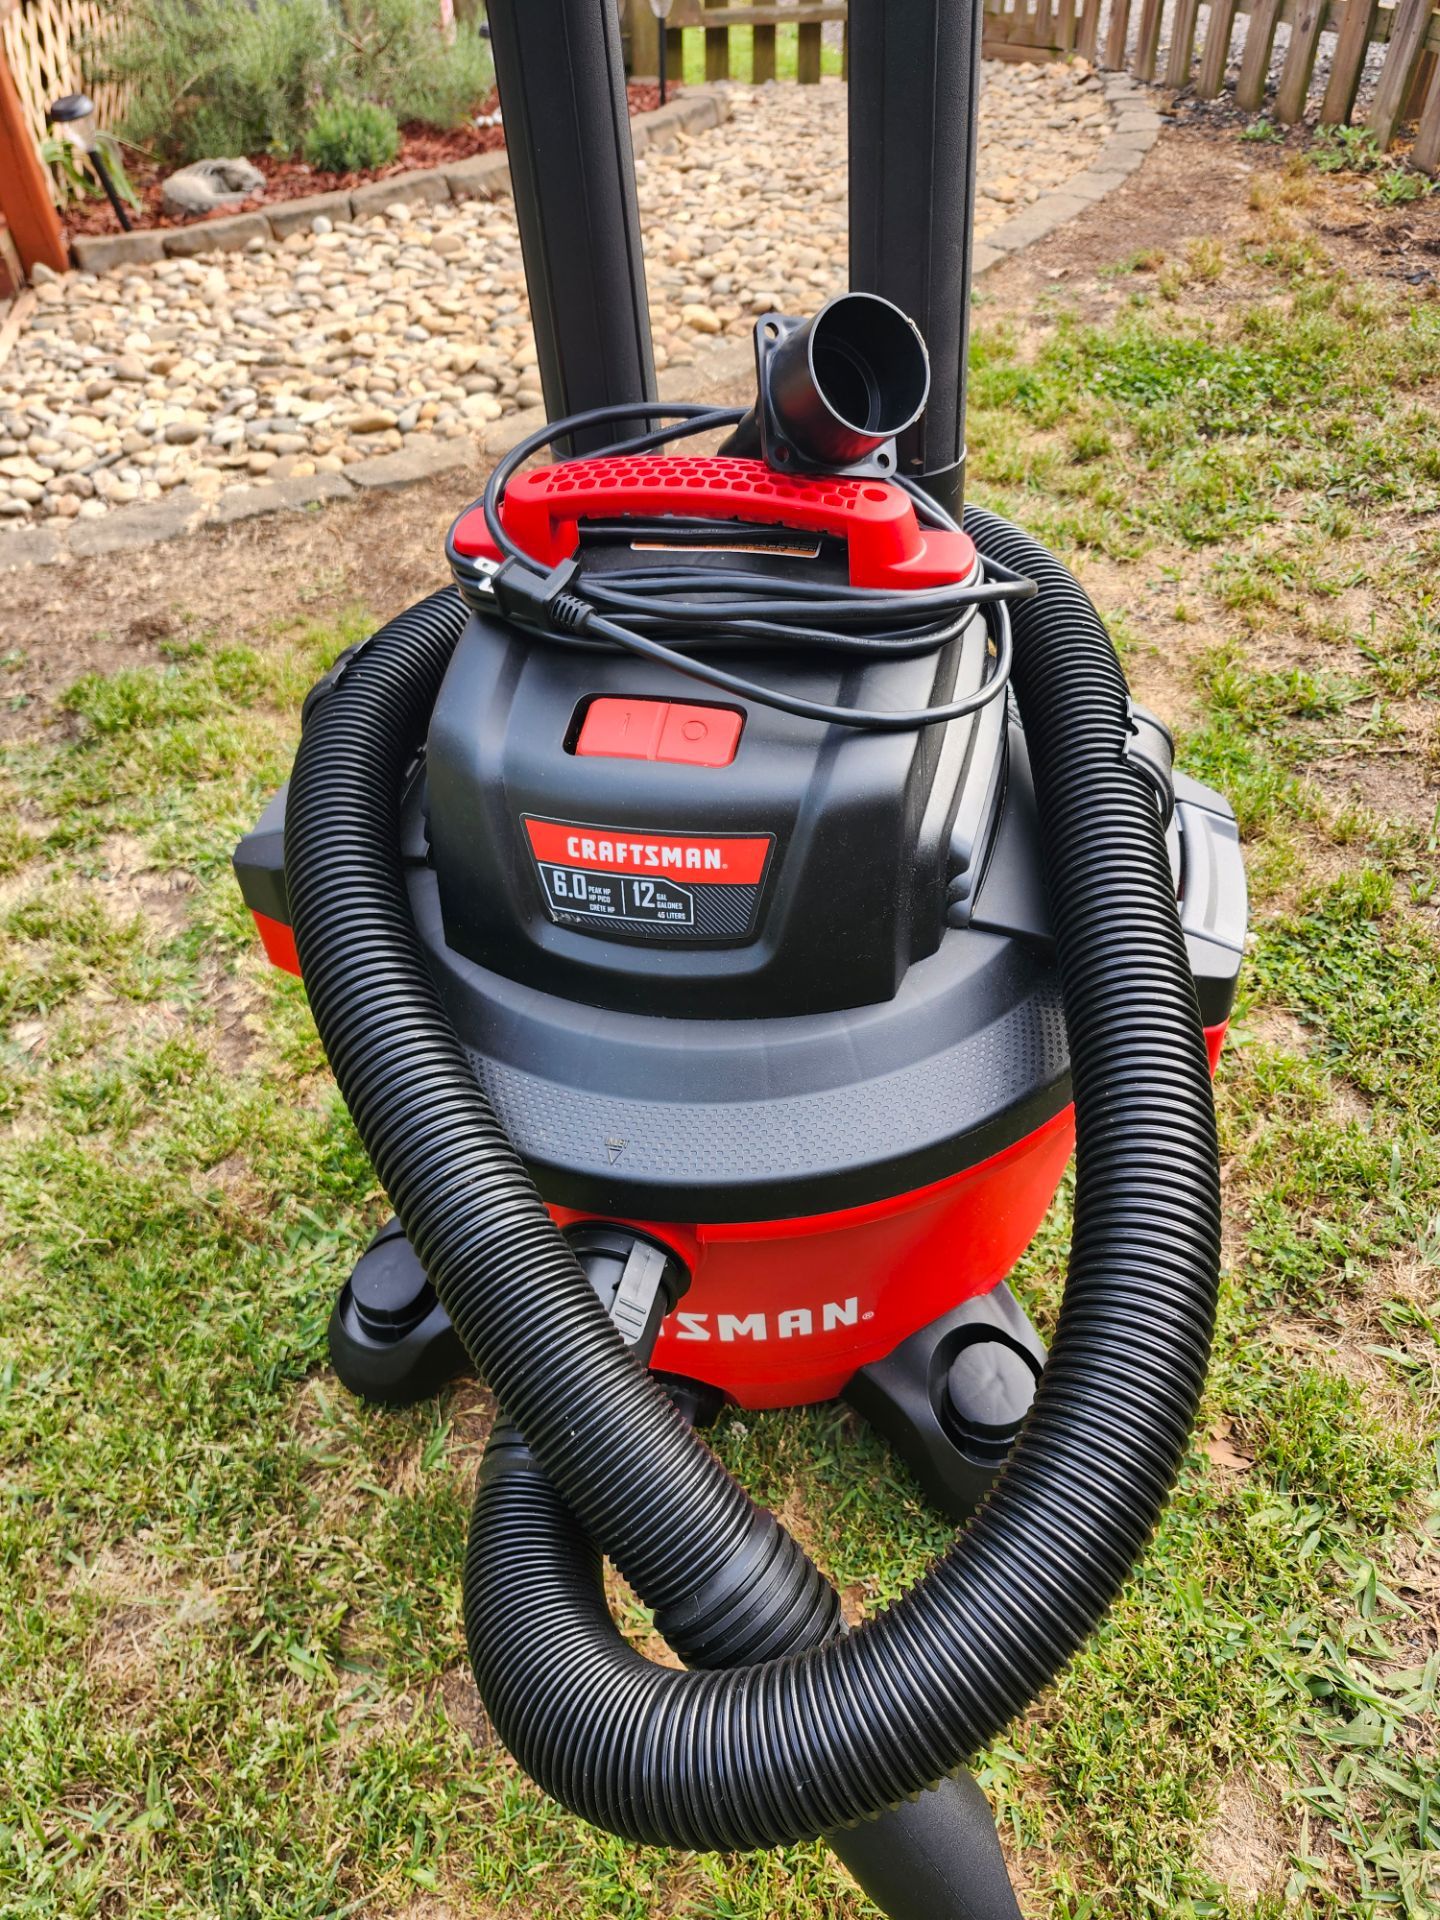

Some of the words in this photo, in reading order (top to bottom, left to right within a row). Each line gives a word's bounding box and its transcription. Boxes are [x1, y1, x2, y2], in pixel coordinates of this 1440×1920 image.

[567, 836, 722, 869] CRAFTSMAN
[553, 870, 587, 900] 6.0
[588, 886, 602, 895] PEAK
[632, 881, 656, 908] 12
[597, 895, 611, 903] PICO
[656, 893, 668, 901] GAL
[656, 901, 683, 910] GALONES
[657, 911, 666, 919] 45
[666, 912, 686, 920] LITERS
